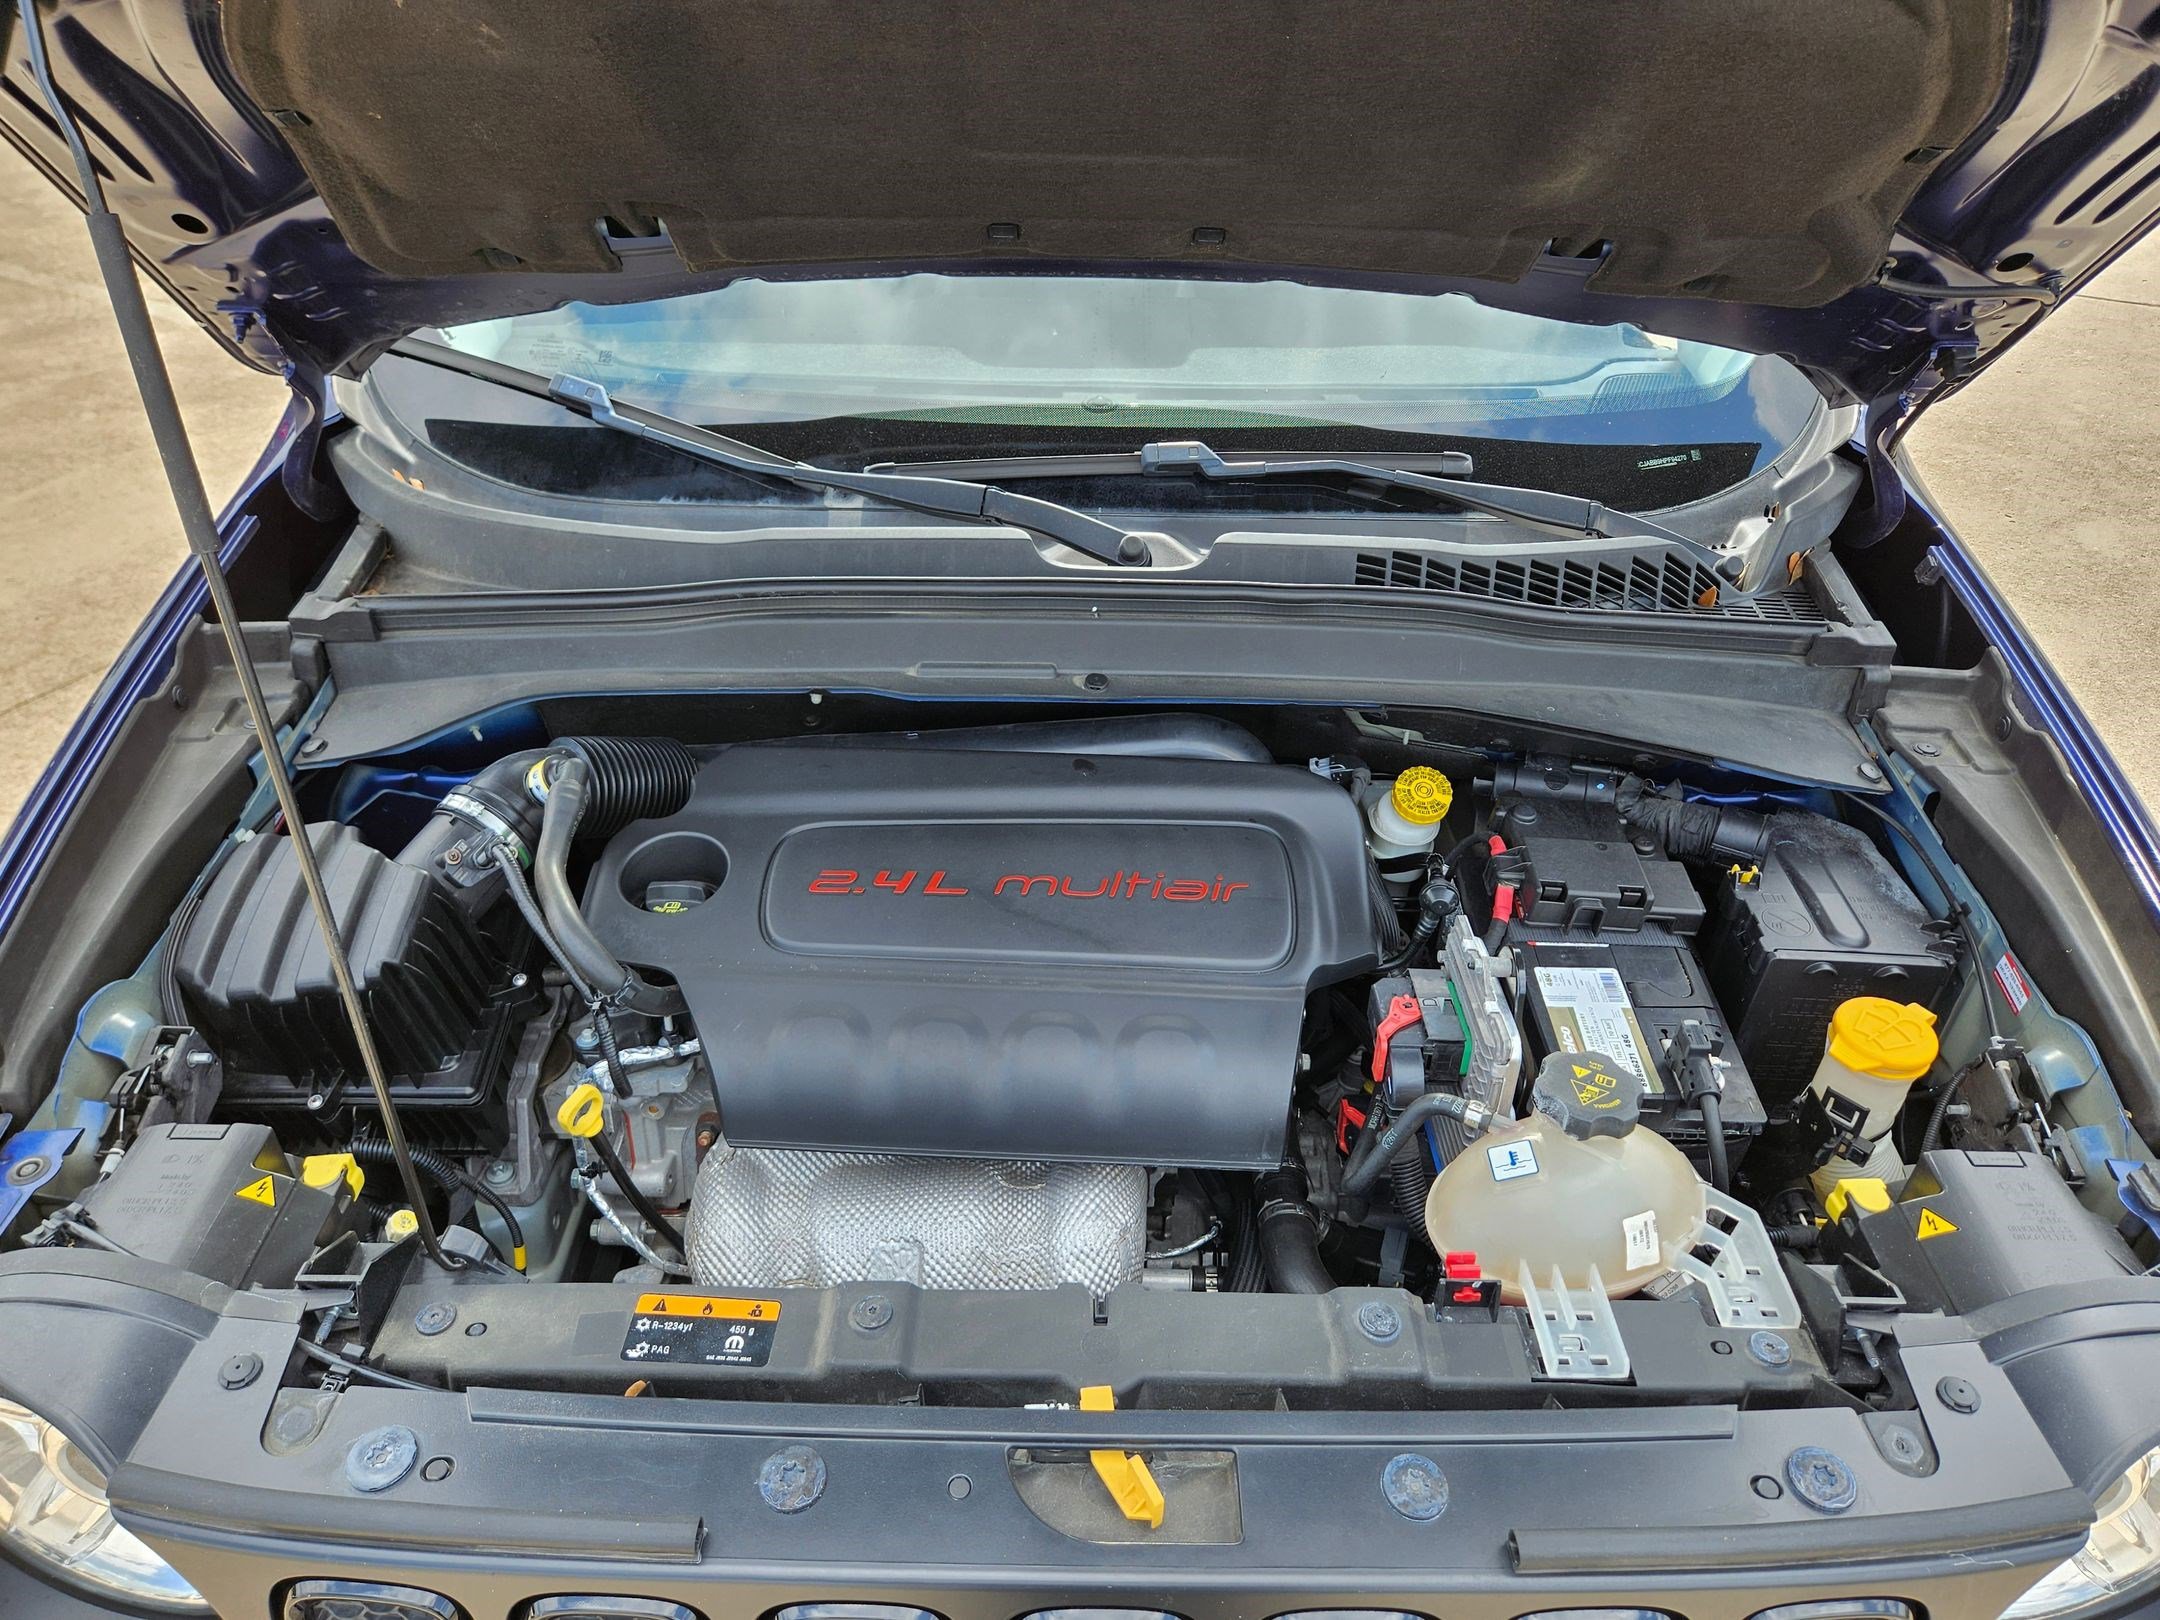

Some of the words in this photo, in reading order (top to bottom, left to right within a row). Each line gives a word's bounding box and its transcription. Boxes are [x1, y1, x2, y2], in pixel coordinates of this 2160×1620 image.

[994, 870, 1249, 903] multiair
[1560, 1025, 1578, 1054] elco
[651, 1321, 693, 1333] R-1234yf
[729, 1325, 746, 1334] 450
[748, 1327, 755, 1336] g
[650, 1345, 670, 1354] PAG
